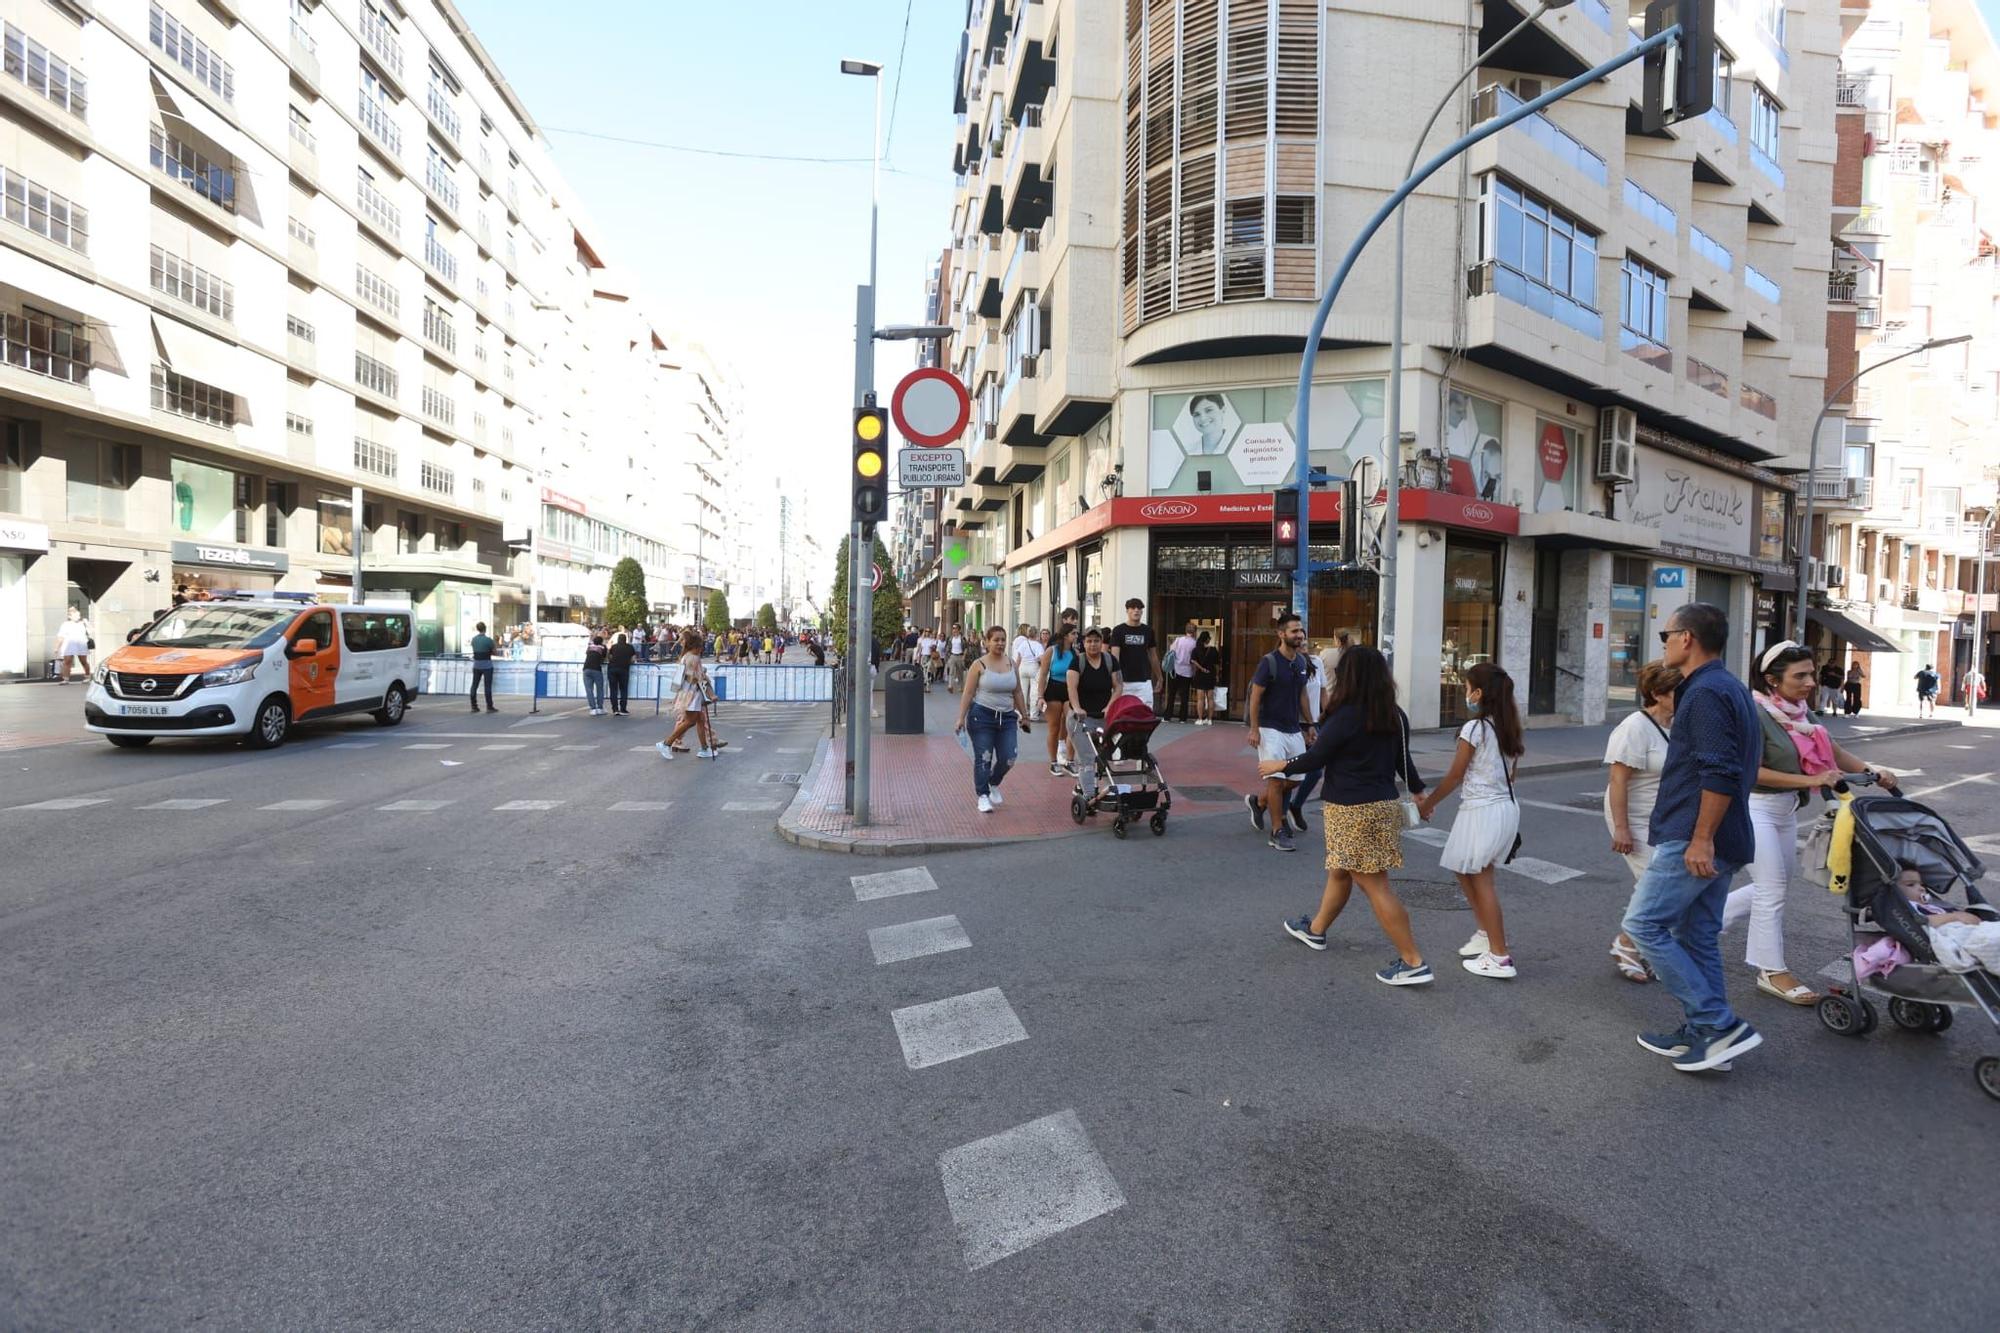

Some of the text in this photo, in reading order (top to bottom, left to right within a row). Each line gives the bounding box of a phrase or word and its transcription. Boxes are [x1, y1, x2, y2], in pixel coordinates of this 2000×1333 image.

[910, 453, 953, 462] EXCEPTO
[1249, 455, 1277, 464] gratuito
[908, 463, 956, 472] TRANSPORTE
[933, 473, 961, 482] URBANO
[1664, 469, 1743, 526] Frank
[1146, 505, 1192, 516] SVENSON
[1219, 504, 1250, 512] Medicina
[1257, 503, 1274, 512] Esté
[195, 546, 251, 565] TEZENIS
[1240, 573, 1281, 584] SUAREZ
[1124, 634, 1145, 646] EA7
